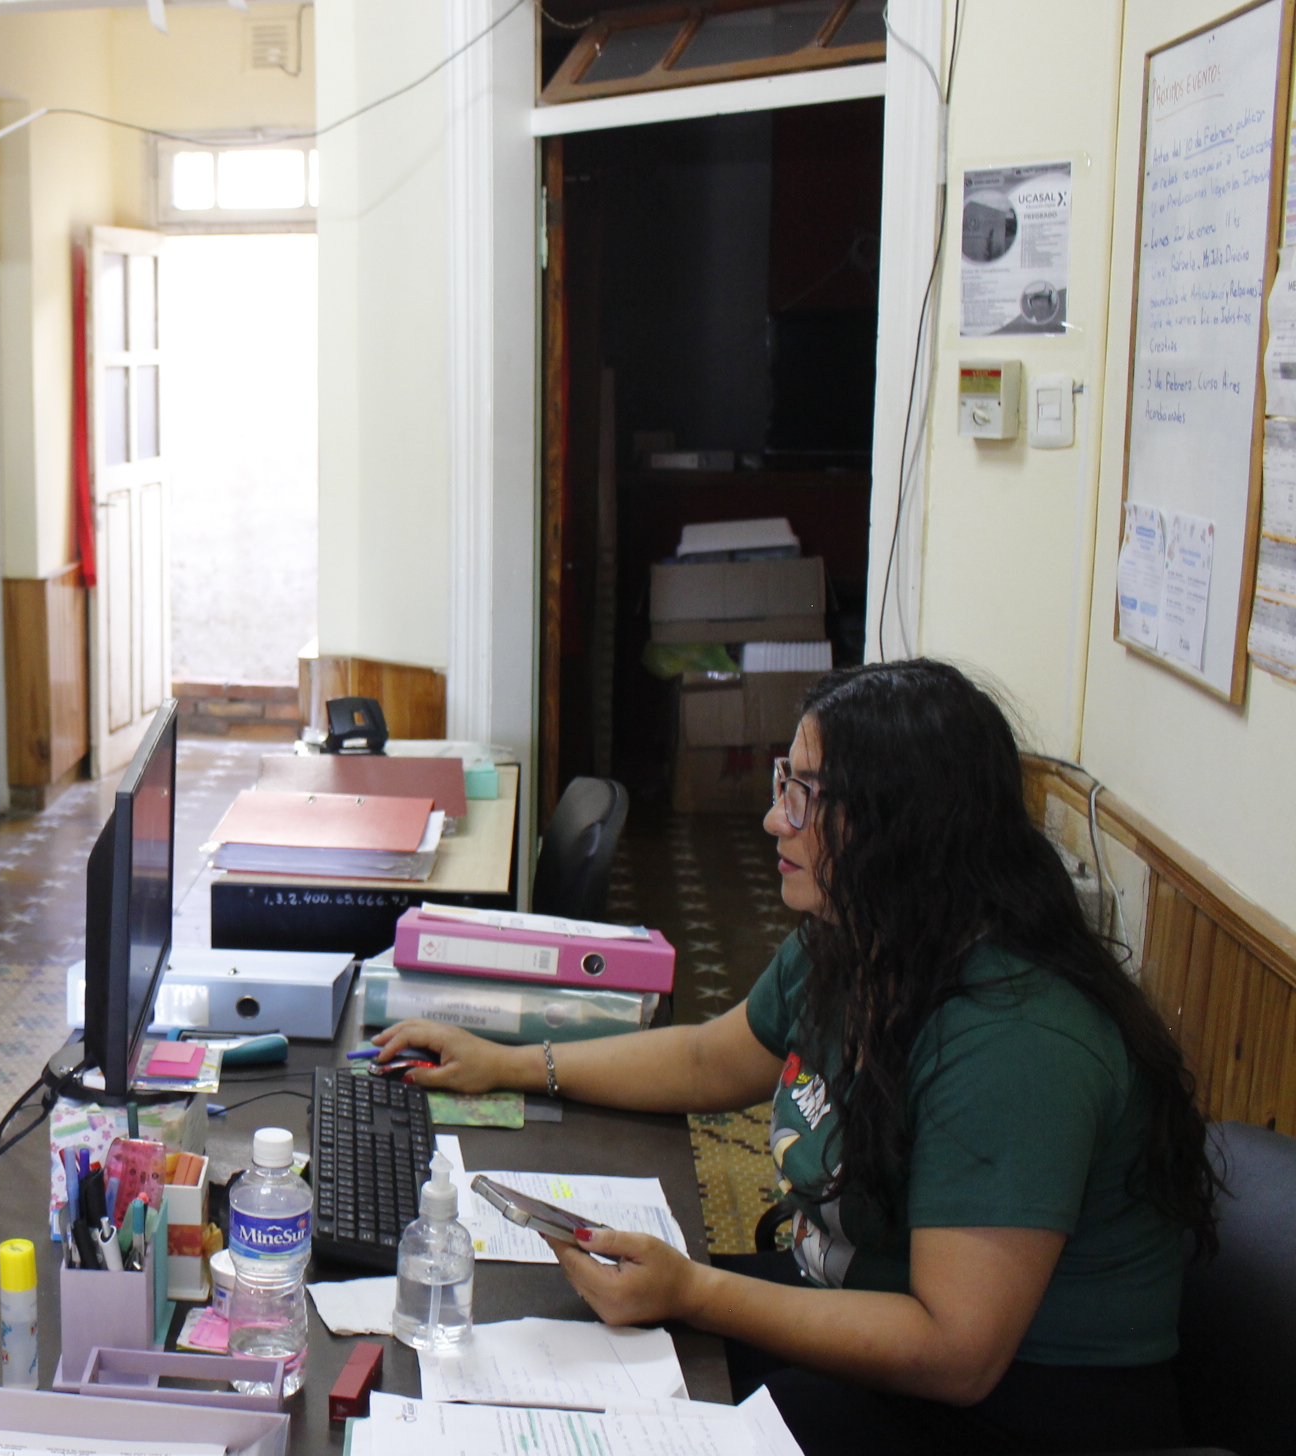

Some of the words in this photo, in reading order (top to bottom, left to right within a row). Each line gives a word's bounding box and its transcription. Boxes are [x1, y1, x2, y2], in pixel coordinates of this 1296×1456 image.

[1018, 193, 1055, 204] UCASAL
[421, 1010, 460, 1022] LECTIVO
[461, 1014, 486, 1026] 2024
[239, 1224, 307, 1245] MineSur
